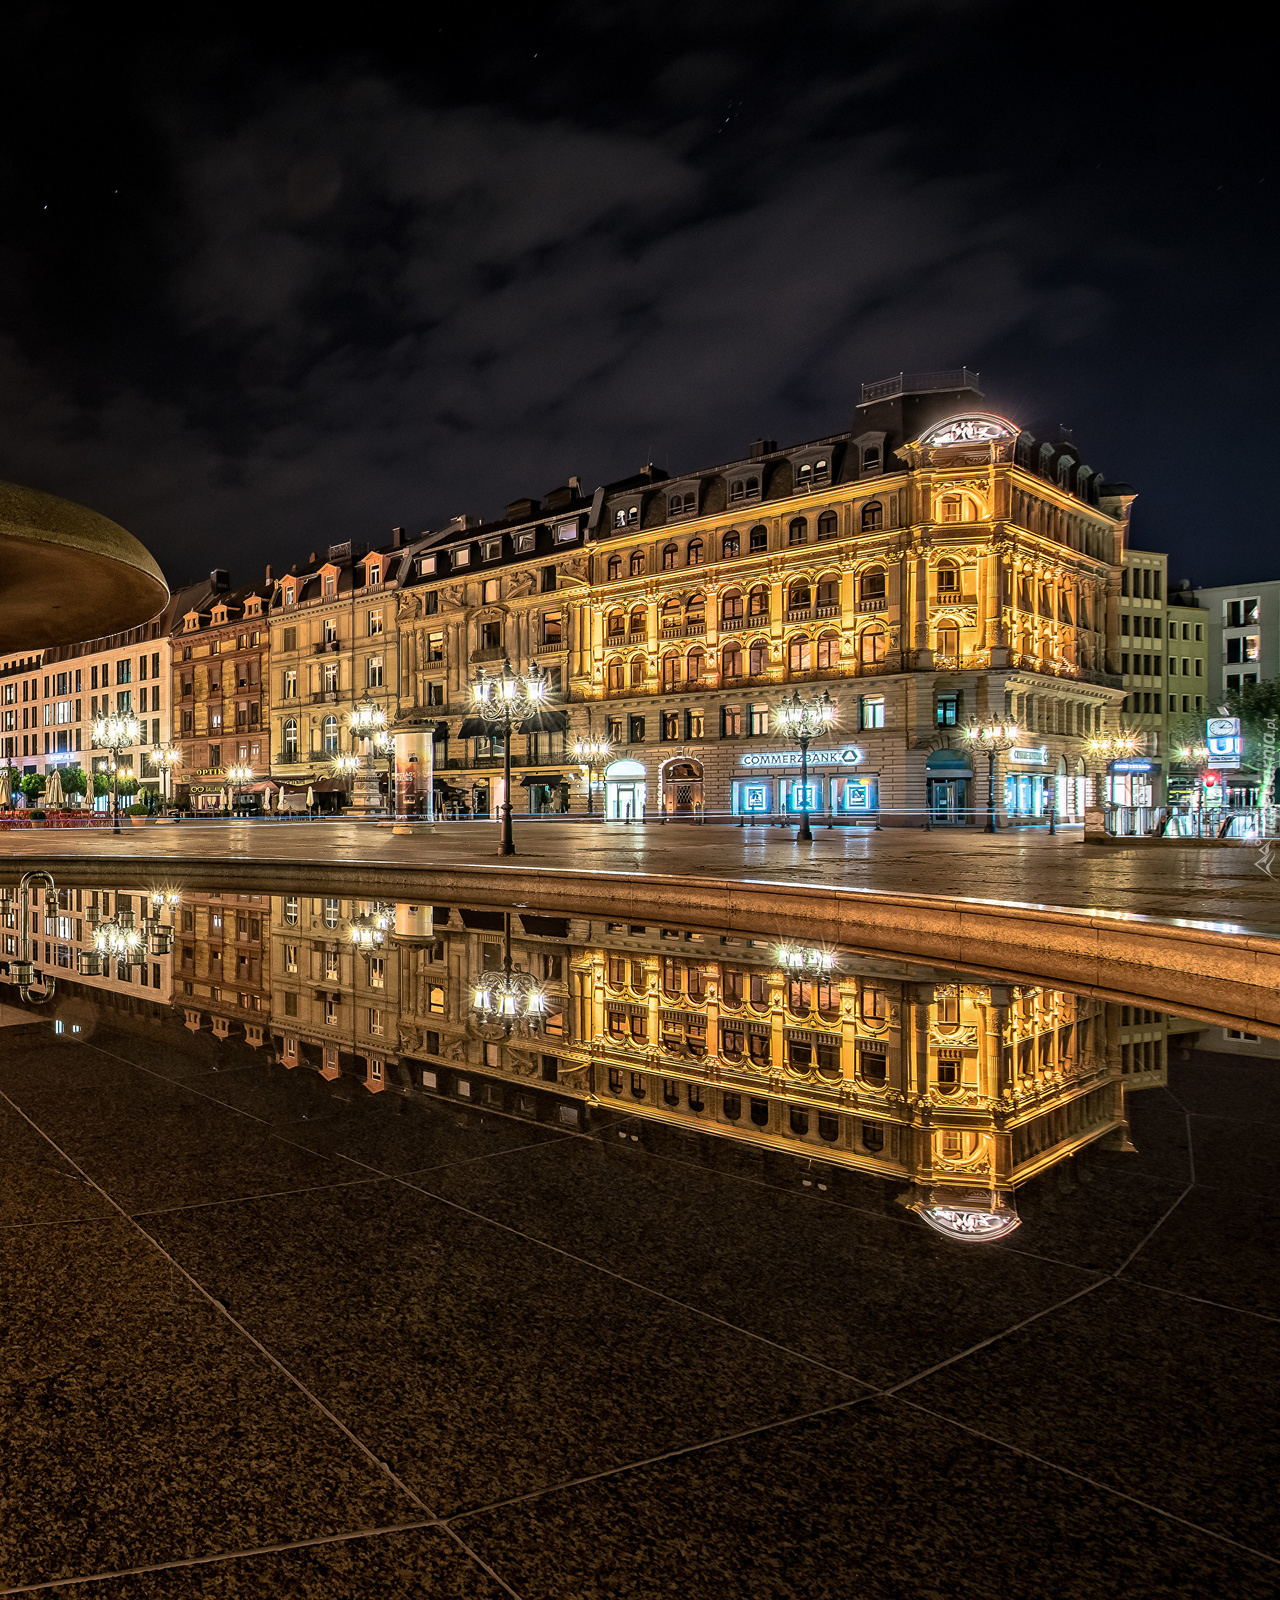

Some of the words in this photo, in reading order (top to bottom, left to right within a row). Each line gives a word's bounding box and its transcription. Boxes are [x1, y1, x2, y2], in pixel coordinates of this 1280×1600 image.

[1210, 738, 1234, 755] U
[743, 752, 839, 765] COMMERZBANK
[196, 768, 224, 776] OPTIK
